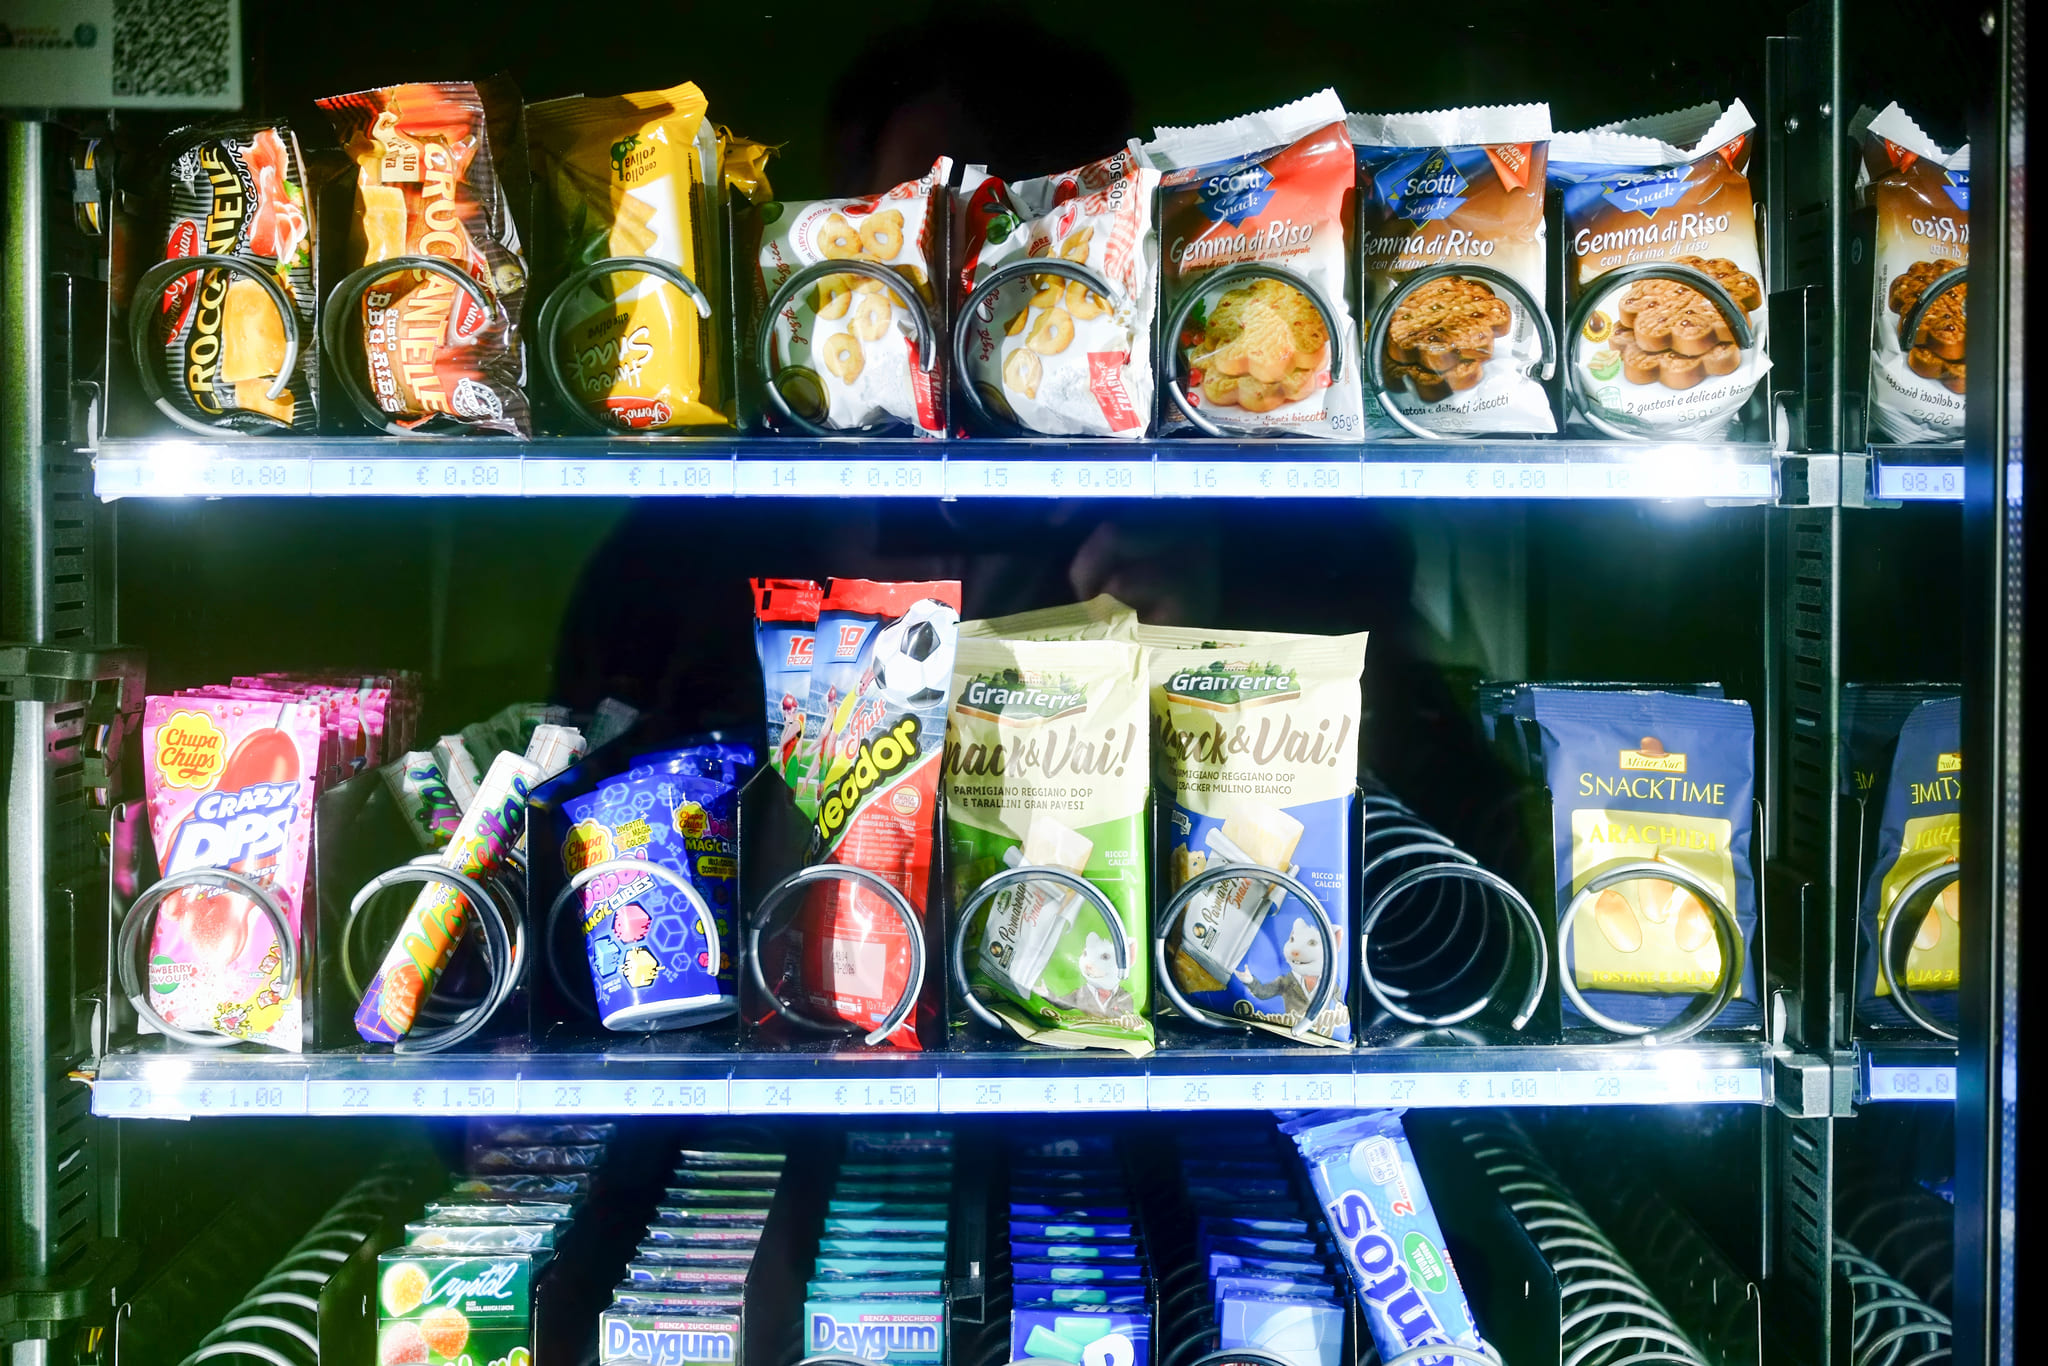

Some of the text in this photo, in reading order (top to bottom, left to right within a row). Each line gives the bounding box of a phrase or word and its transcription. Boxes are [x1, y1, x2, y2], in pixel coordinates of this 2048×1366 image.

[1495, 148, 1520, 173] RICETTA
[1207, 167, 1265, 197] Scotti
[1405, 174, 1457, 197] Scotti
[1108, 180, 1128, 211] 50g
[798, 214, 814, 252] LIEVITO
[1169, 219, 1313, 264] Gemma di Riso
[1426, 234, 1446, 255] di
[1445, 229, 1495, 258] Riso
[1574, 212, 1730, 257] Gemma di Riso
[165, 226, 194, 297] Diani
[1600, 239, 1710, 267] con farina di riso
[399, 143, 463, 414] CROCANTELLE
[386, 309, 397, 351] gusto
[782, 304, 809, 345] gusto
[566, 325, 654, 374] Snack
[372, 351, 400, 413] RIBS
[628, 401, 674, 426] Forno
[1625, 402, 1635, 415] 2
[1636, 398, 1675, 416] gustosi
[1677, 397, 1684, 406] e
[1686, 388, 1727, 405] delicati
[1291, 408, 1329, 424] biscotti
[230, 465, 287, 486] 0.80
[346, 465, 500, 487] 12 € 0.80
[560, 466, 712, 488] 13 € 1.00
[772, 466, 922, 488] 14 € 0.80
[983, 467, 1133, 488] 15 € 0.80
[1192, 467, 1341, 488] 16 € 0.80
[1400, 469, 1546, 489] 17 € 0.80
[839, 625, 865, 646] 10
[1171, 674, 1290, 692] GranTerre
[968, 682, 1081, 709] GranTerre
[165, 728, 219, 753] Chupa
[845, 699, 888, 760] Fruit
[1228, 713, 1351, 768] & Vai!
[160, 746, 216, 775] Chups
[945, 735, 1027, 778] nack
[1042, 722, 1137, 779] Vai!
[1626, 757, 1681, 769] Mister Nut
[1221, 771, 1296, 782] REGGIANO DOP
[953, 785, 1094, 798] PARMIGIANO REGGIANO DOP
[1212, 783, 1252, 794] MULINO
[1255, 784, 1292, 795] BIANCO
[1579, 772, 1726, 805] SNACKTIME
[199, 783, 294, 820] CRAZY
[963, 798, 1085, 811] E TARALLINI GRAN PAVESI
[166, 806, 295, 875] DIPS
[567, 836, 603, 855] Chupa
[685, 838, 723, 854] MAGIC
[1588, 823, 1717, 852] ARACHIDI
[566, 850, 604, 872] Chups
[1311, 871, 1334, 881] RICCO
[1314, 880, 1342, 889] CALCIO
[582, 876, 656, 936] MAGIC CUBES
[1592, 970, 1667, 984] TOSTATE E
[229, 1087, 284, 1108] 1.00
[341, 1086, 495, 1108] 22 € 1.50
[554, 1086, 706, 1107] 23 € 2.50
[765, 1085, 917, 1107] 24 € 1.50
[975, 1083, 1126, 1105] 25 € 1.20
[1183, 1081, 1333, 1103] 26 € 1.20
[1389, 1077, 1537, 1100] 27 € 1.00
[1594, 1076, 1621, 1097] 28
[1393, 1200, 1415, 1217] 2
[421, 1260, 519, 1311] Crystal
[658, 1321, 733, 1332] SENZA ZUCCHERO
[863, 1315, 937, 1323] SENZA ZUCCHERO
[603, 1318, 735, 1366] Daygum
[810, 1312, 940, 1362] Daygum
